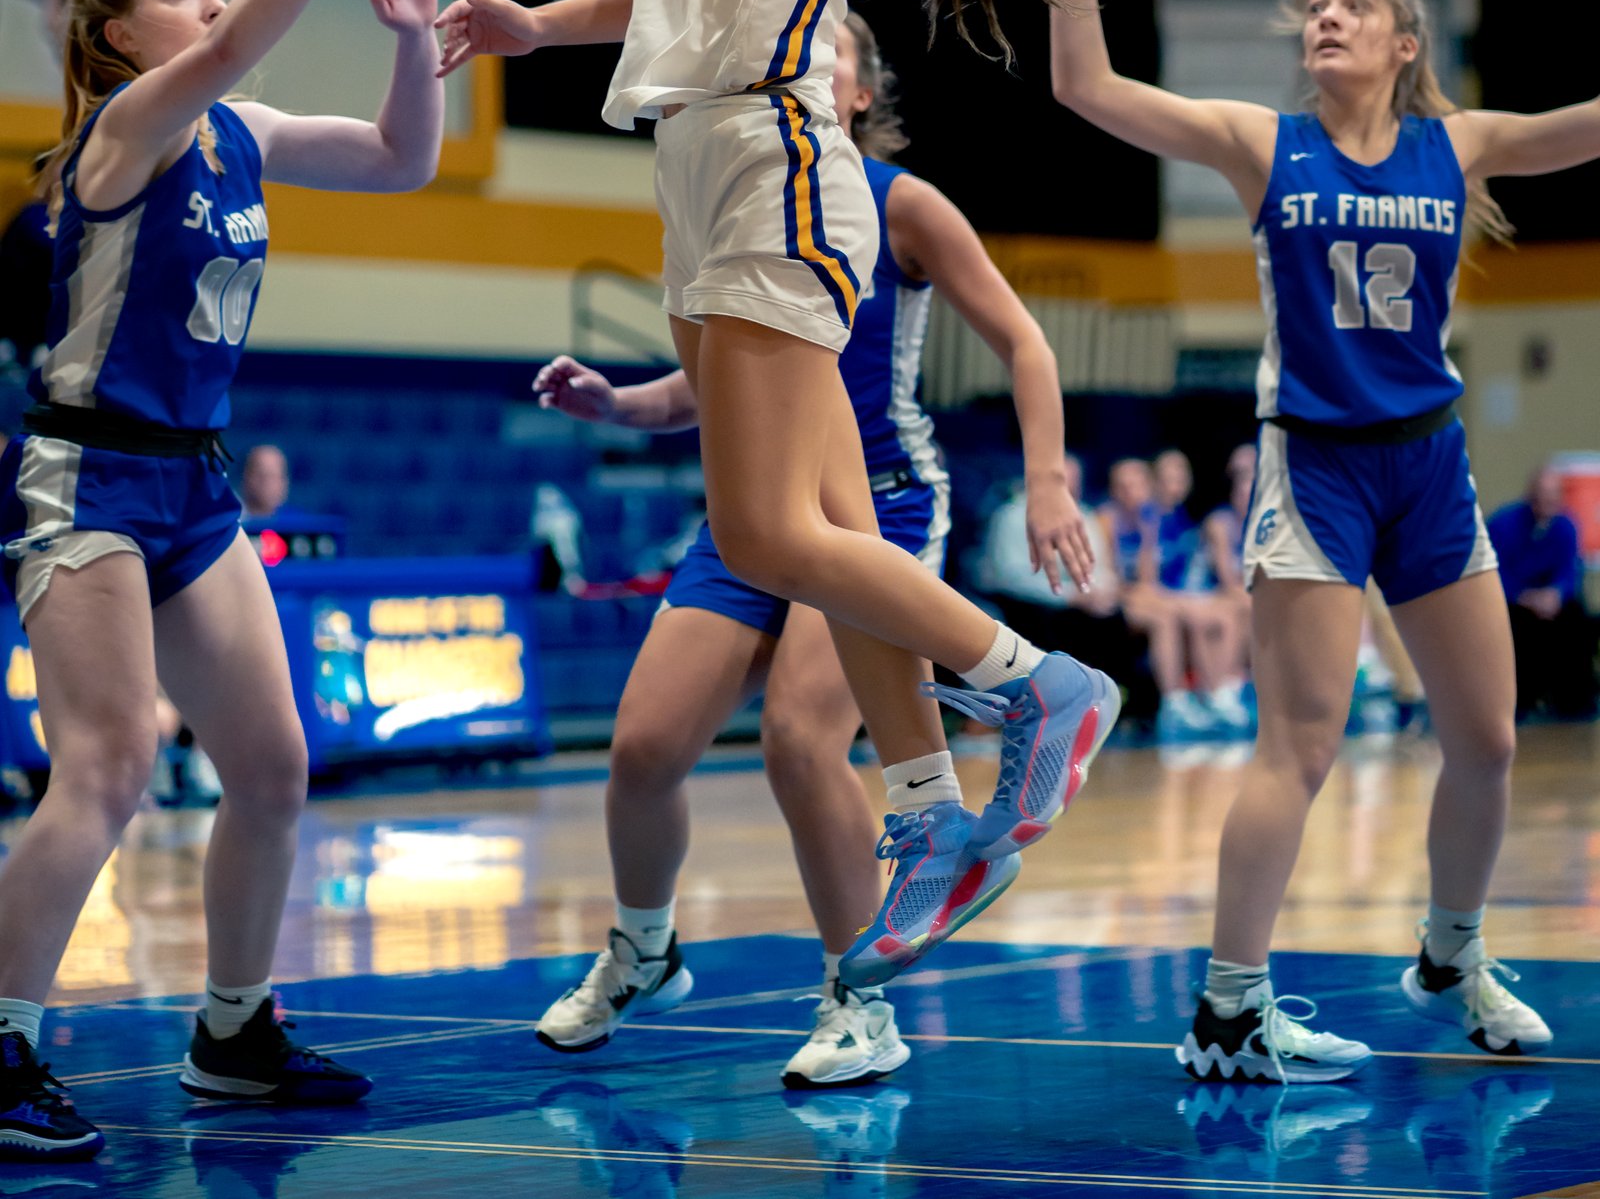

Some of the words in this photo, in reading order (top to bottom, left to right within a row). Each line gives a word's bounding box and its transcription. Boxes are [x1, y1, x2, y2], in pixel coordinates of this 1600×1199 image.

[1281, 192, 1328, 229] ST.
[1337, 193, 1456, 235] FRANCIS
[1328, 240, 1416, 332] 12
